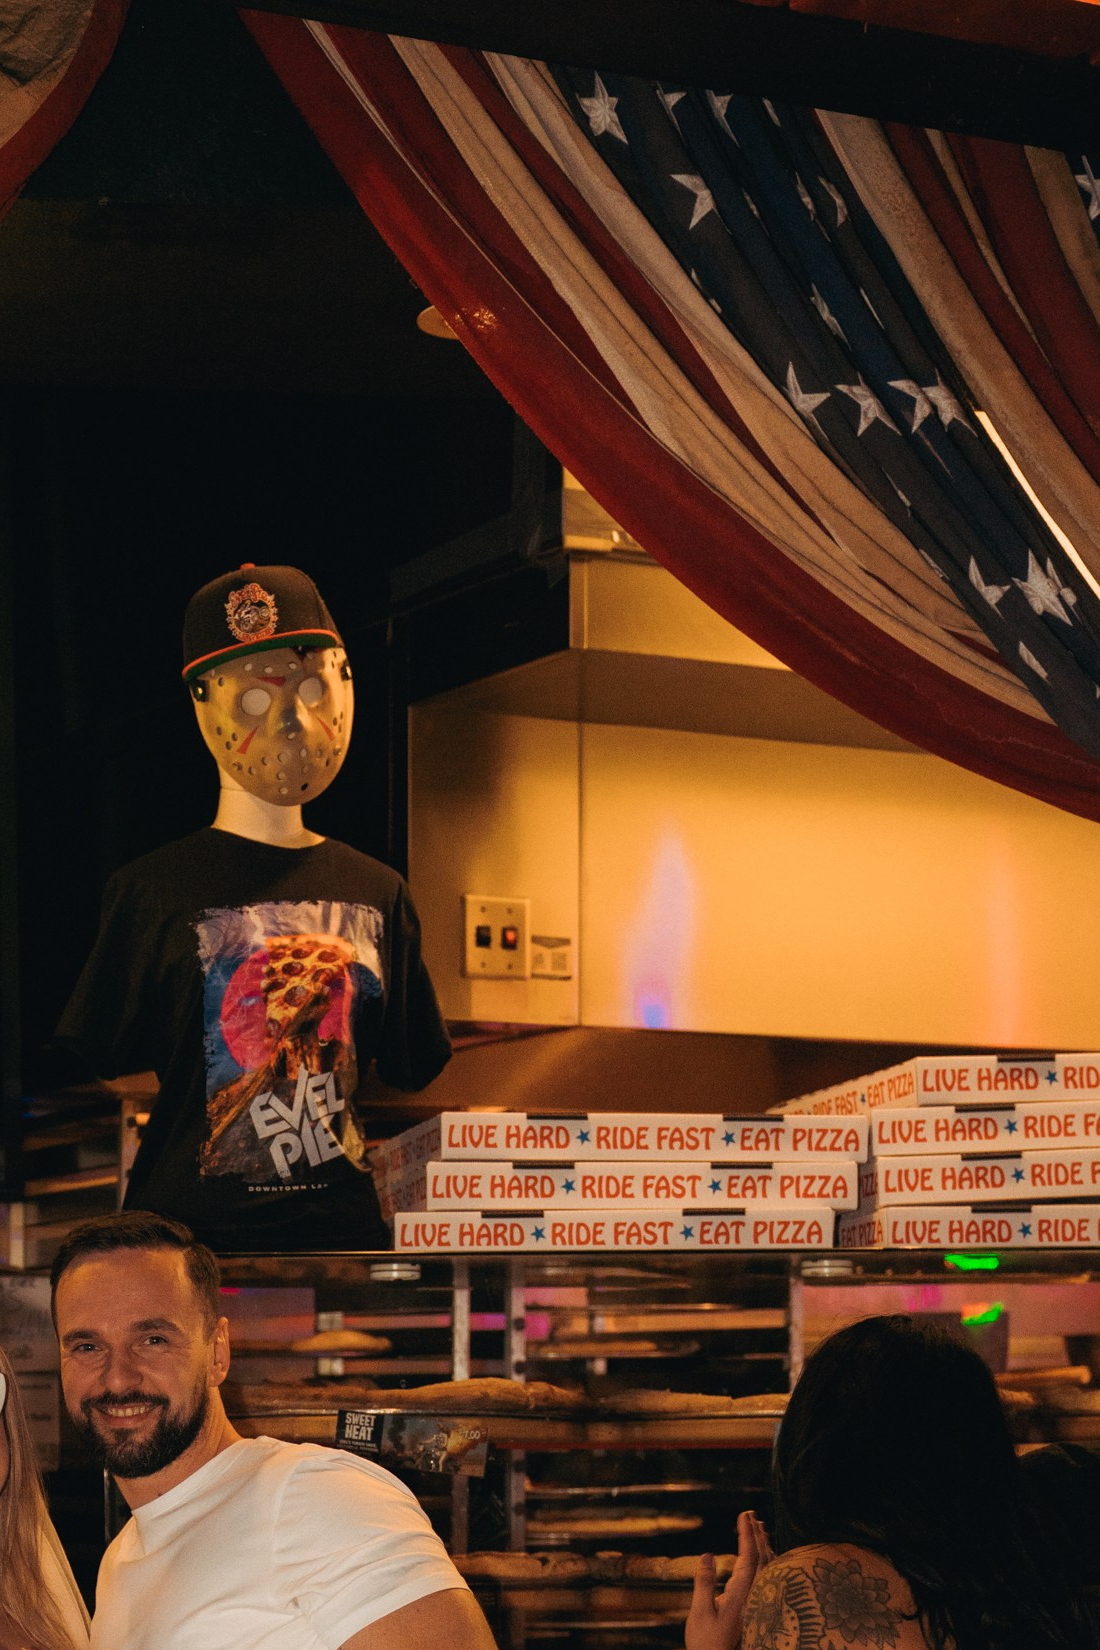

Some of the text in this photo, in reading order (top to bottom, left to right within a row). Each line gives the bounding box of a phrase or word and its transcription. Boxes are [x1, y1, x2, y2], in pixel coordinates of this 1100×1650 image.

[867, 1084, 887, 1107] EAT
[887, 1071, 914, 1101] PIZZA
[922, 1068, 970, 1092] LIVE
[977, 1067, 1039, 1091] HARD
[250, 1063, 345, 1139] EVEL
[447, 1124, 860, 1152] LIVE HARD RIDE FAST EAT PIZZA
[878, 1119, 926, 1144] LIVE
[934, 1117, 998, 1142] HARD
[1024, 1113, 1076, 1138] RIDE
[270, 1114, 346, 1183] PIE
[248, 1184, 307, 1192] DOWNTOWN
[432, 1174, 848, 1199] LIVE HARD RIDE FAST EAT PIZZA
[884, 1167, 933, 1193] LIVE
[941, 1165, 1005, 1190] HARD
[1031, 1161, 1084, 1187] RIDE
[400, 1220, 823, 1247] LIVE HARD RIDE FAST EAT PIZZA
[892, 1218, 1090, 1244] LIVE HARD RIDE
[345, 1412, 376, 1427] SWEET
[344, 1426, 375, 1441] HEAT
